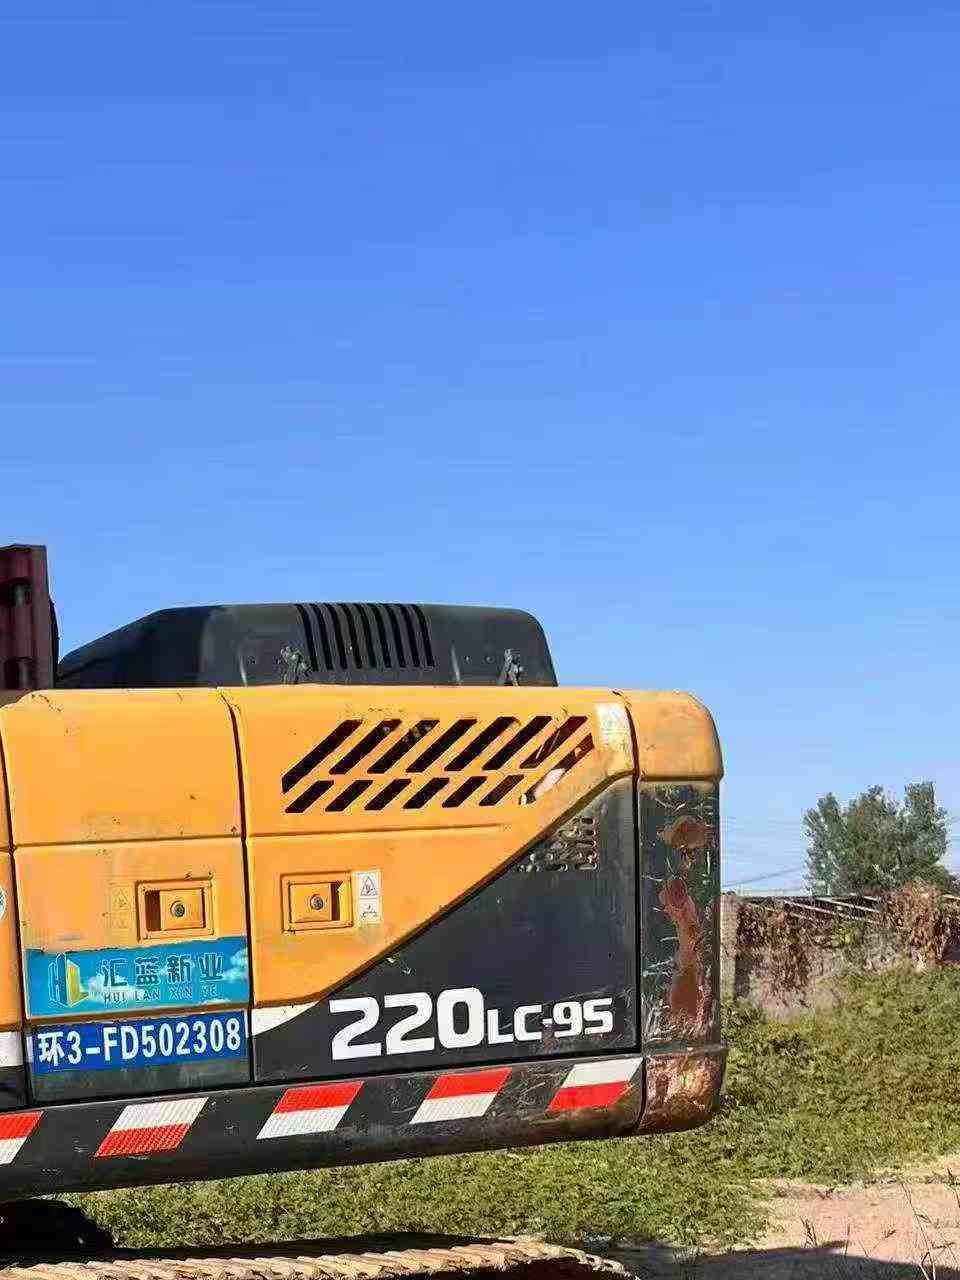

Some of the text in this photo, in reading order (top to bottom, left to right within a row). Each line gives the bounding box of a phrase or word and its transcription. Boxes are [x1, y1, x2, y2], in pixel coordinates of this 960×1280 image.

[100, 952, 225, 987] 汇蓝新业
[104, 991, 127, 1003] HUI
[135, 989, 161, 1001] LAN
[38, 1017, 241, 1067] 环3-FD502308
